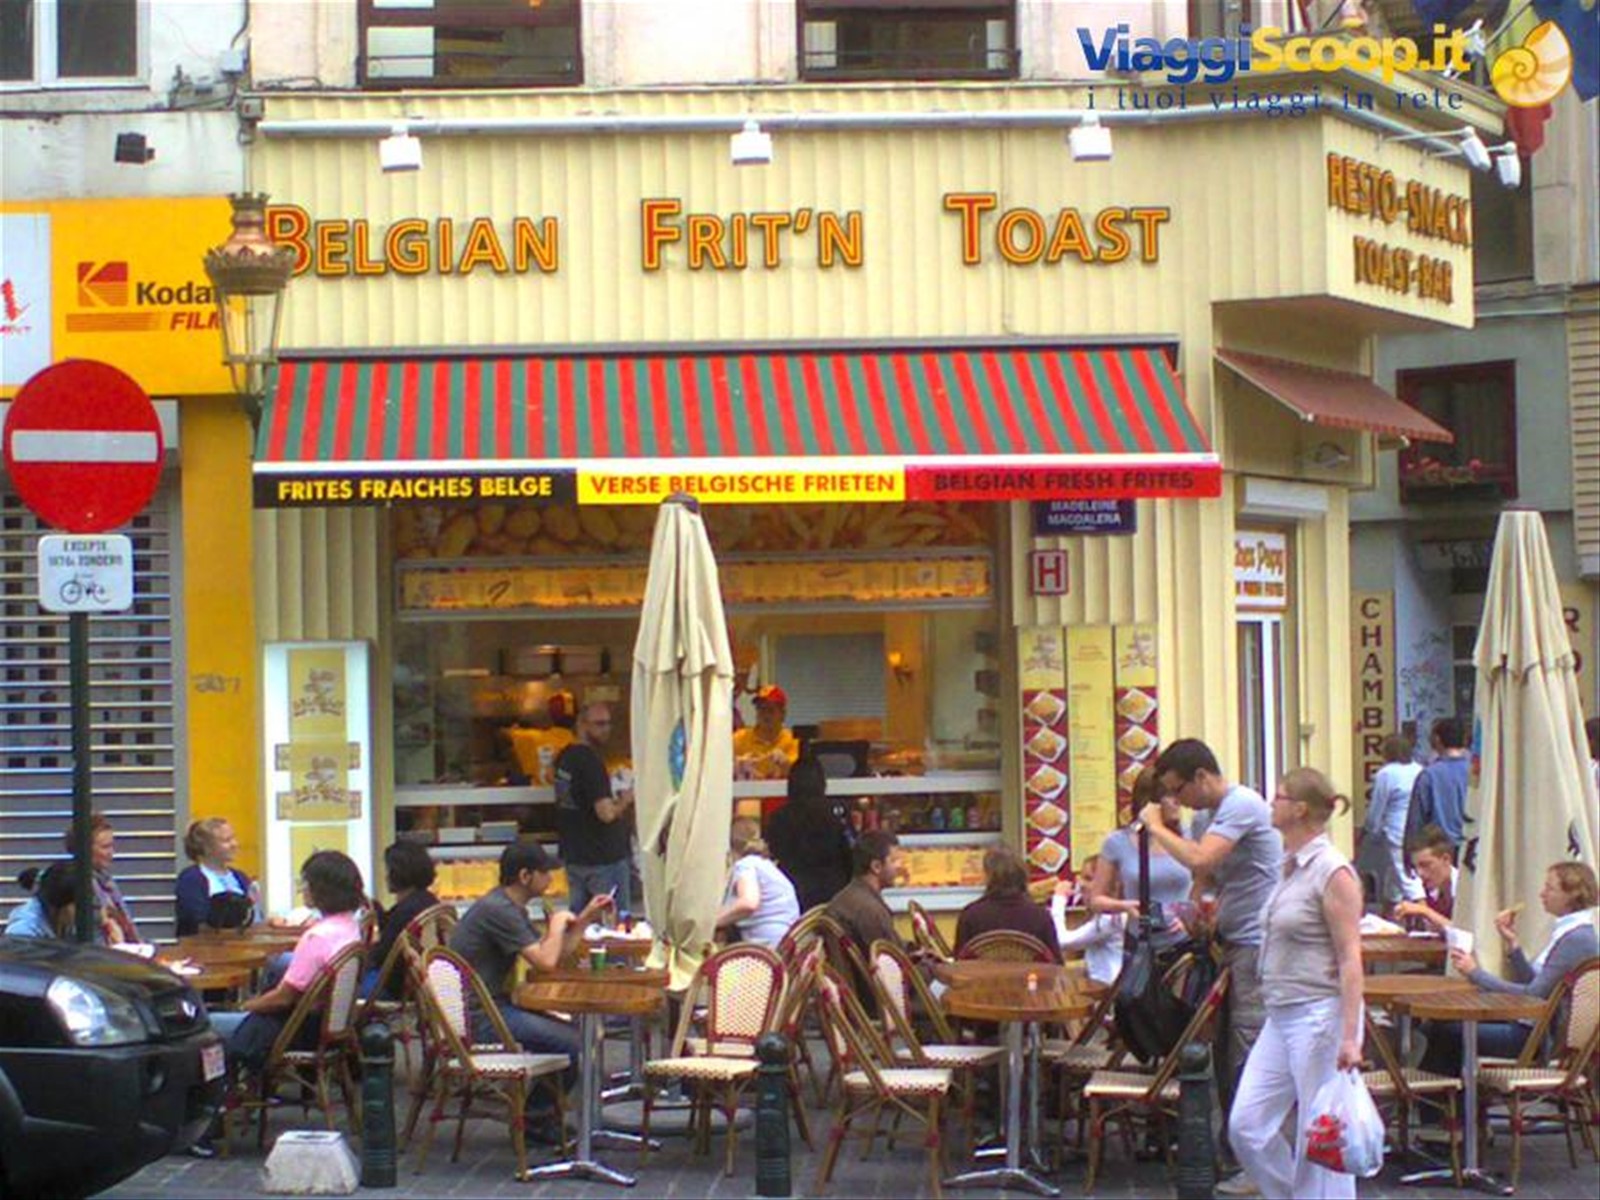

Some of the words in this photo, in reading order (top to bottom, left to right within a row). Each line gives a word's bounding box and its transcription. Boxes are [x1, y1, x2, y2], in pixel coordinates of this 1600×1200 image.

[1327, 152, 1470, 249] RESTO-SNACK
[264, 204, 558, 276] BELGIAN
[641, 199, 863, 270] FRIT'N
[944, 192, 1170, 265] TOAST
[1353, 235, 1453, 305] TOAST-BAR
[278, 480, 352, 500] FRITES
[360, 478, 472, 499] FRAICHES
[480, 476, 552, 497] BELGE
[591, 475, 660, 495] VERSE
[669, 474, 795, 494] BELGISCHE
[804, 474, 895, 493] FRIETEN
[935, 473, 1035, 491] BELGIAN
[1045, 472, 1113, 491] FRESH
[1122, 471, 1194, 490] FRITES
[1051, 500, 1117, 512] MADELEINE
[1038, 555, 1061, 590] H
